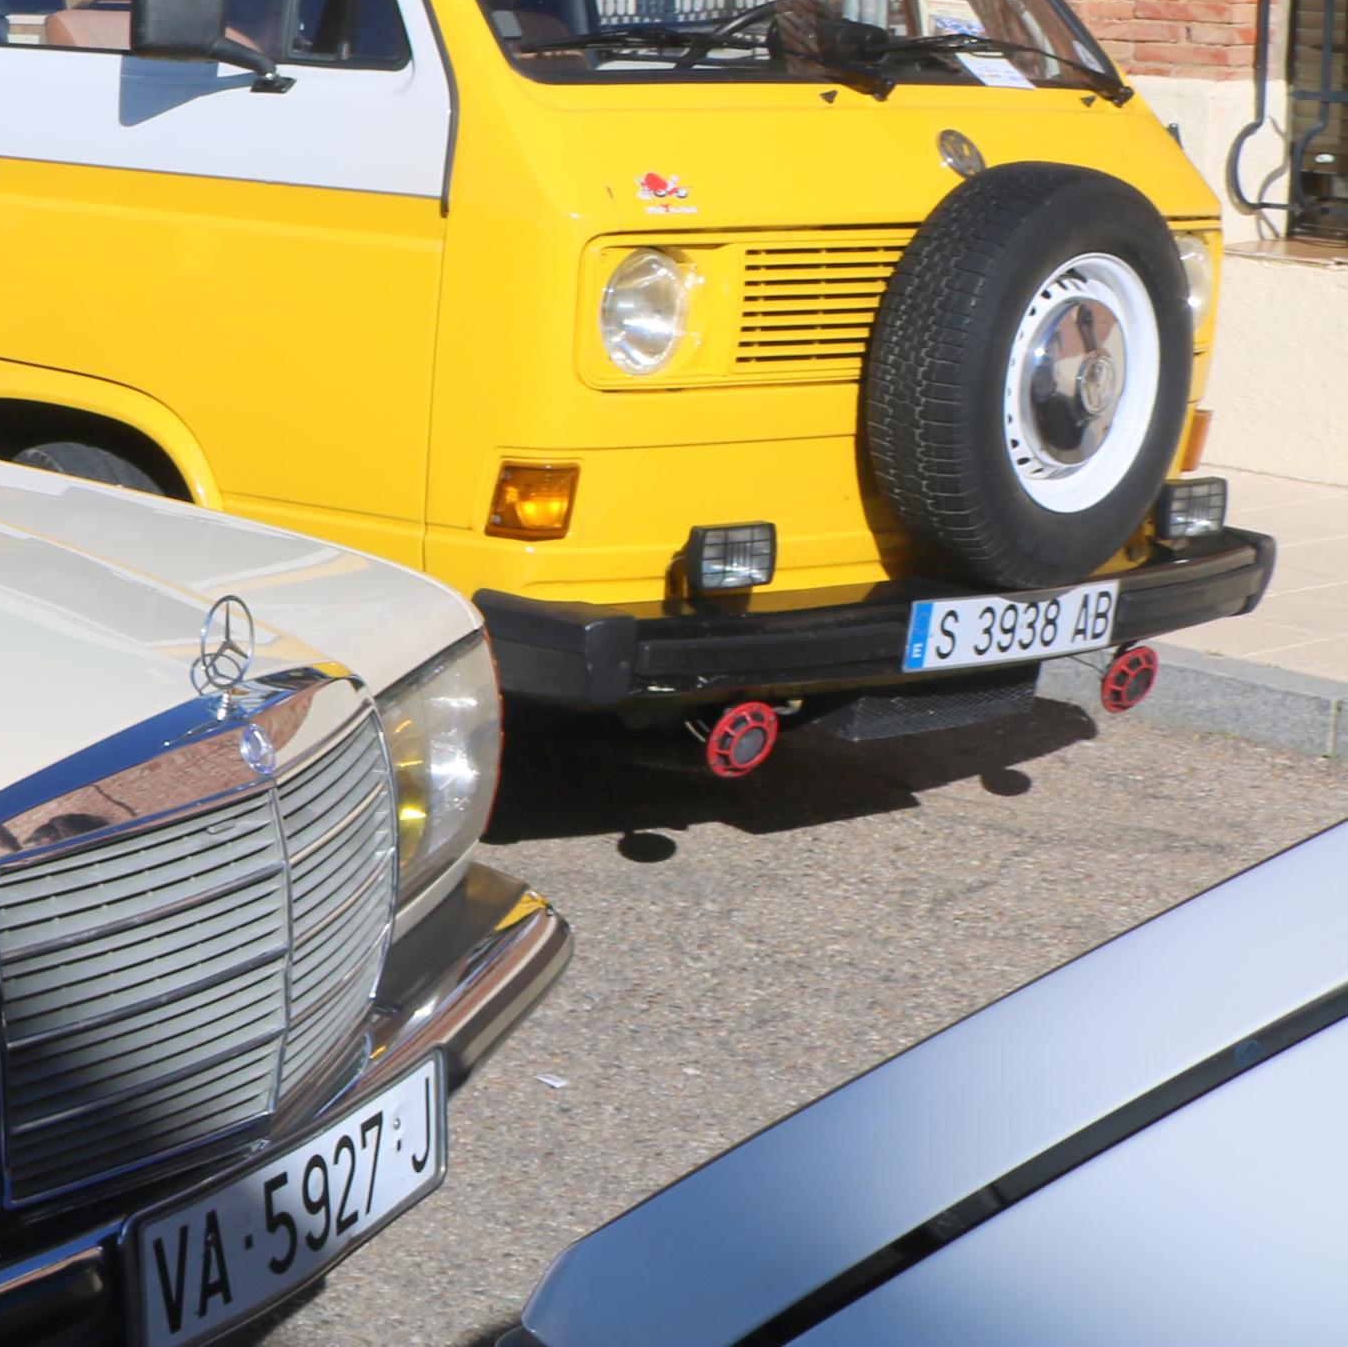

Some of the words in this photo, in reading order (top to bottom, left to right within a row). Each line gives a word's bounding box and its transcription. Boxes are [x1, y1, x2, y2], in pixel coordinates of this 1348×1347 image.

[935, 609, 960, 660] S
[973, 597, 1061, 656] 3938
[1071, 590, 1113, 644] AB
